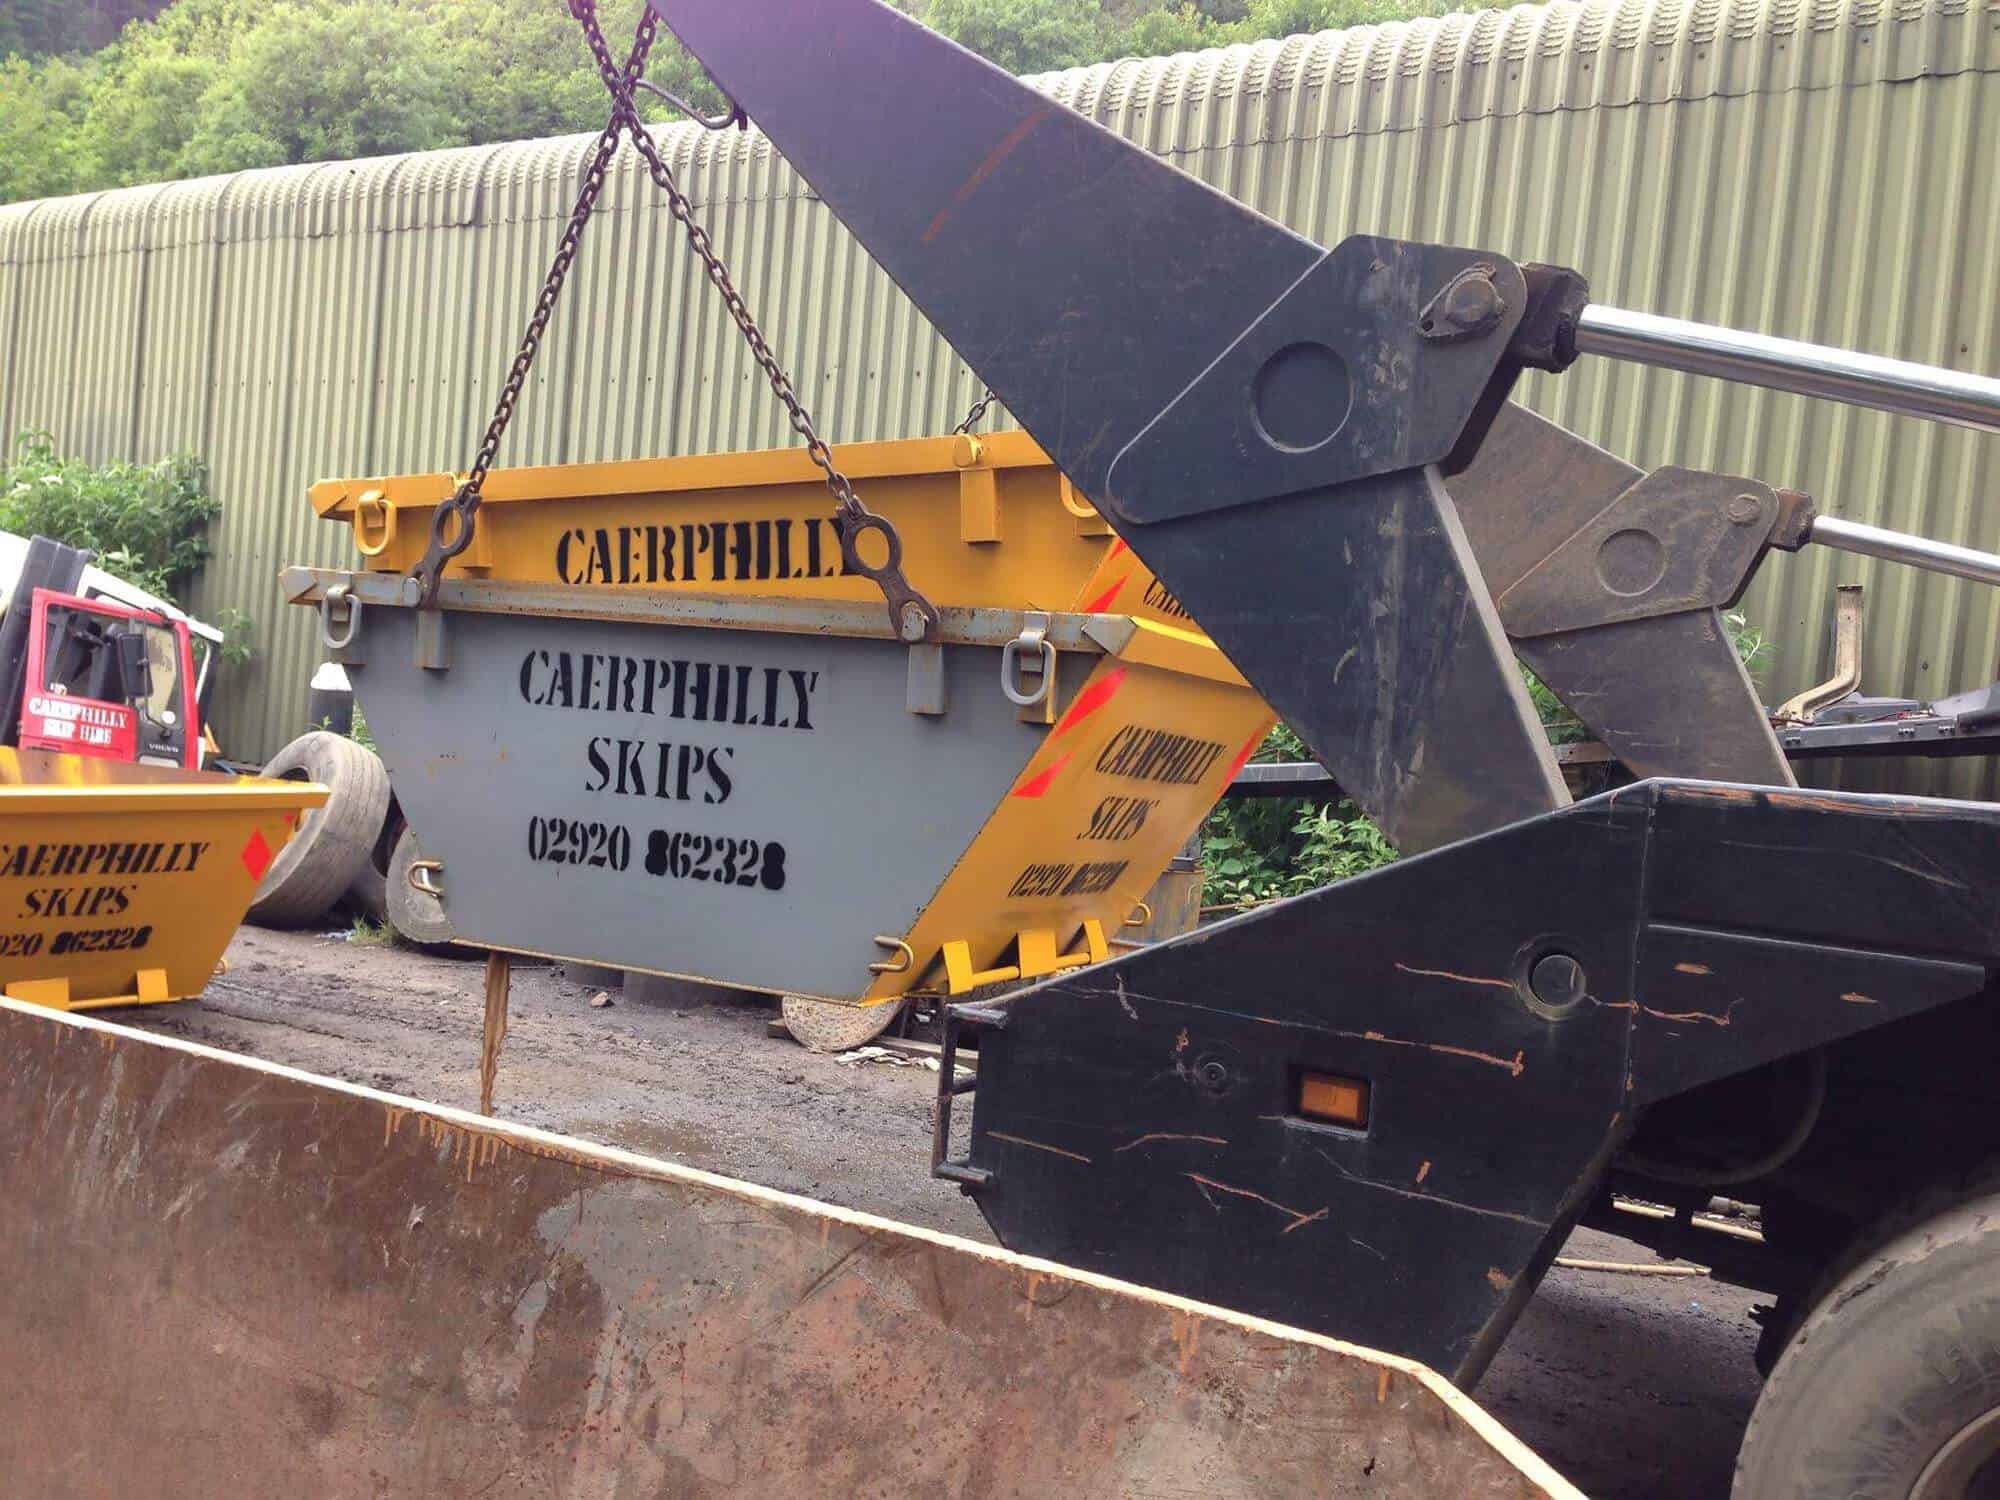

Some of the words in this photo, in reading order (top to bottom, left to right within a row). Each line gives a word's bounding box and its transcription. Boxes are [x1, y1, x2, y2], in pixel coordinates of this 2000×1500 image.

[519, 650, 819, 729] CAERPHILLY
[585, 736, 734, 804] SKIPS
[1096, 724, 1226, 785] CAERPHILLY
[528, 816, 631, 872] 02920
[644, 829, 787, 891] 862328
[18, 884, 138, 919] SKIPS
